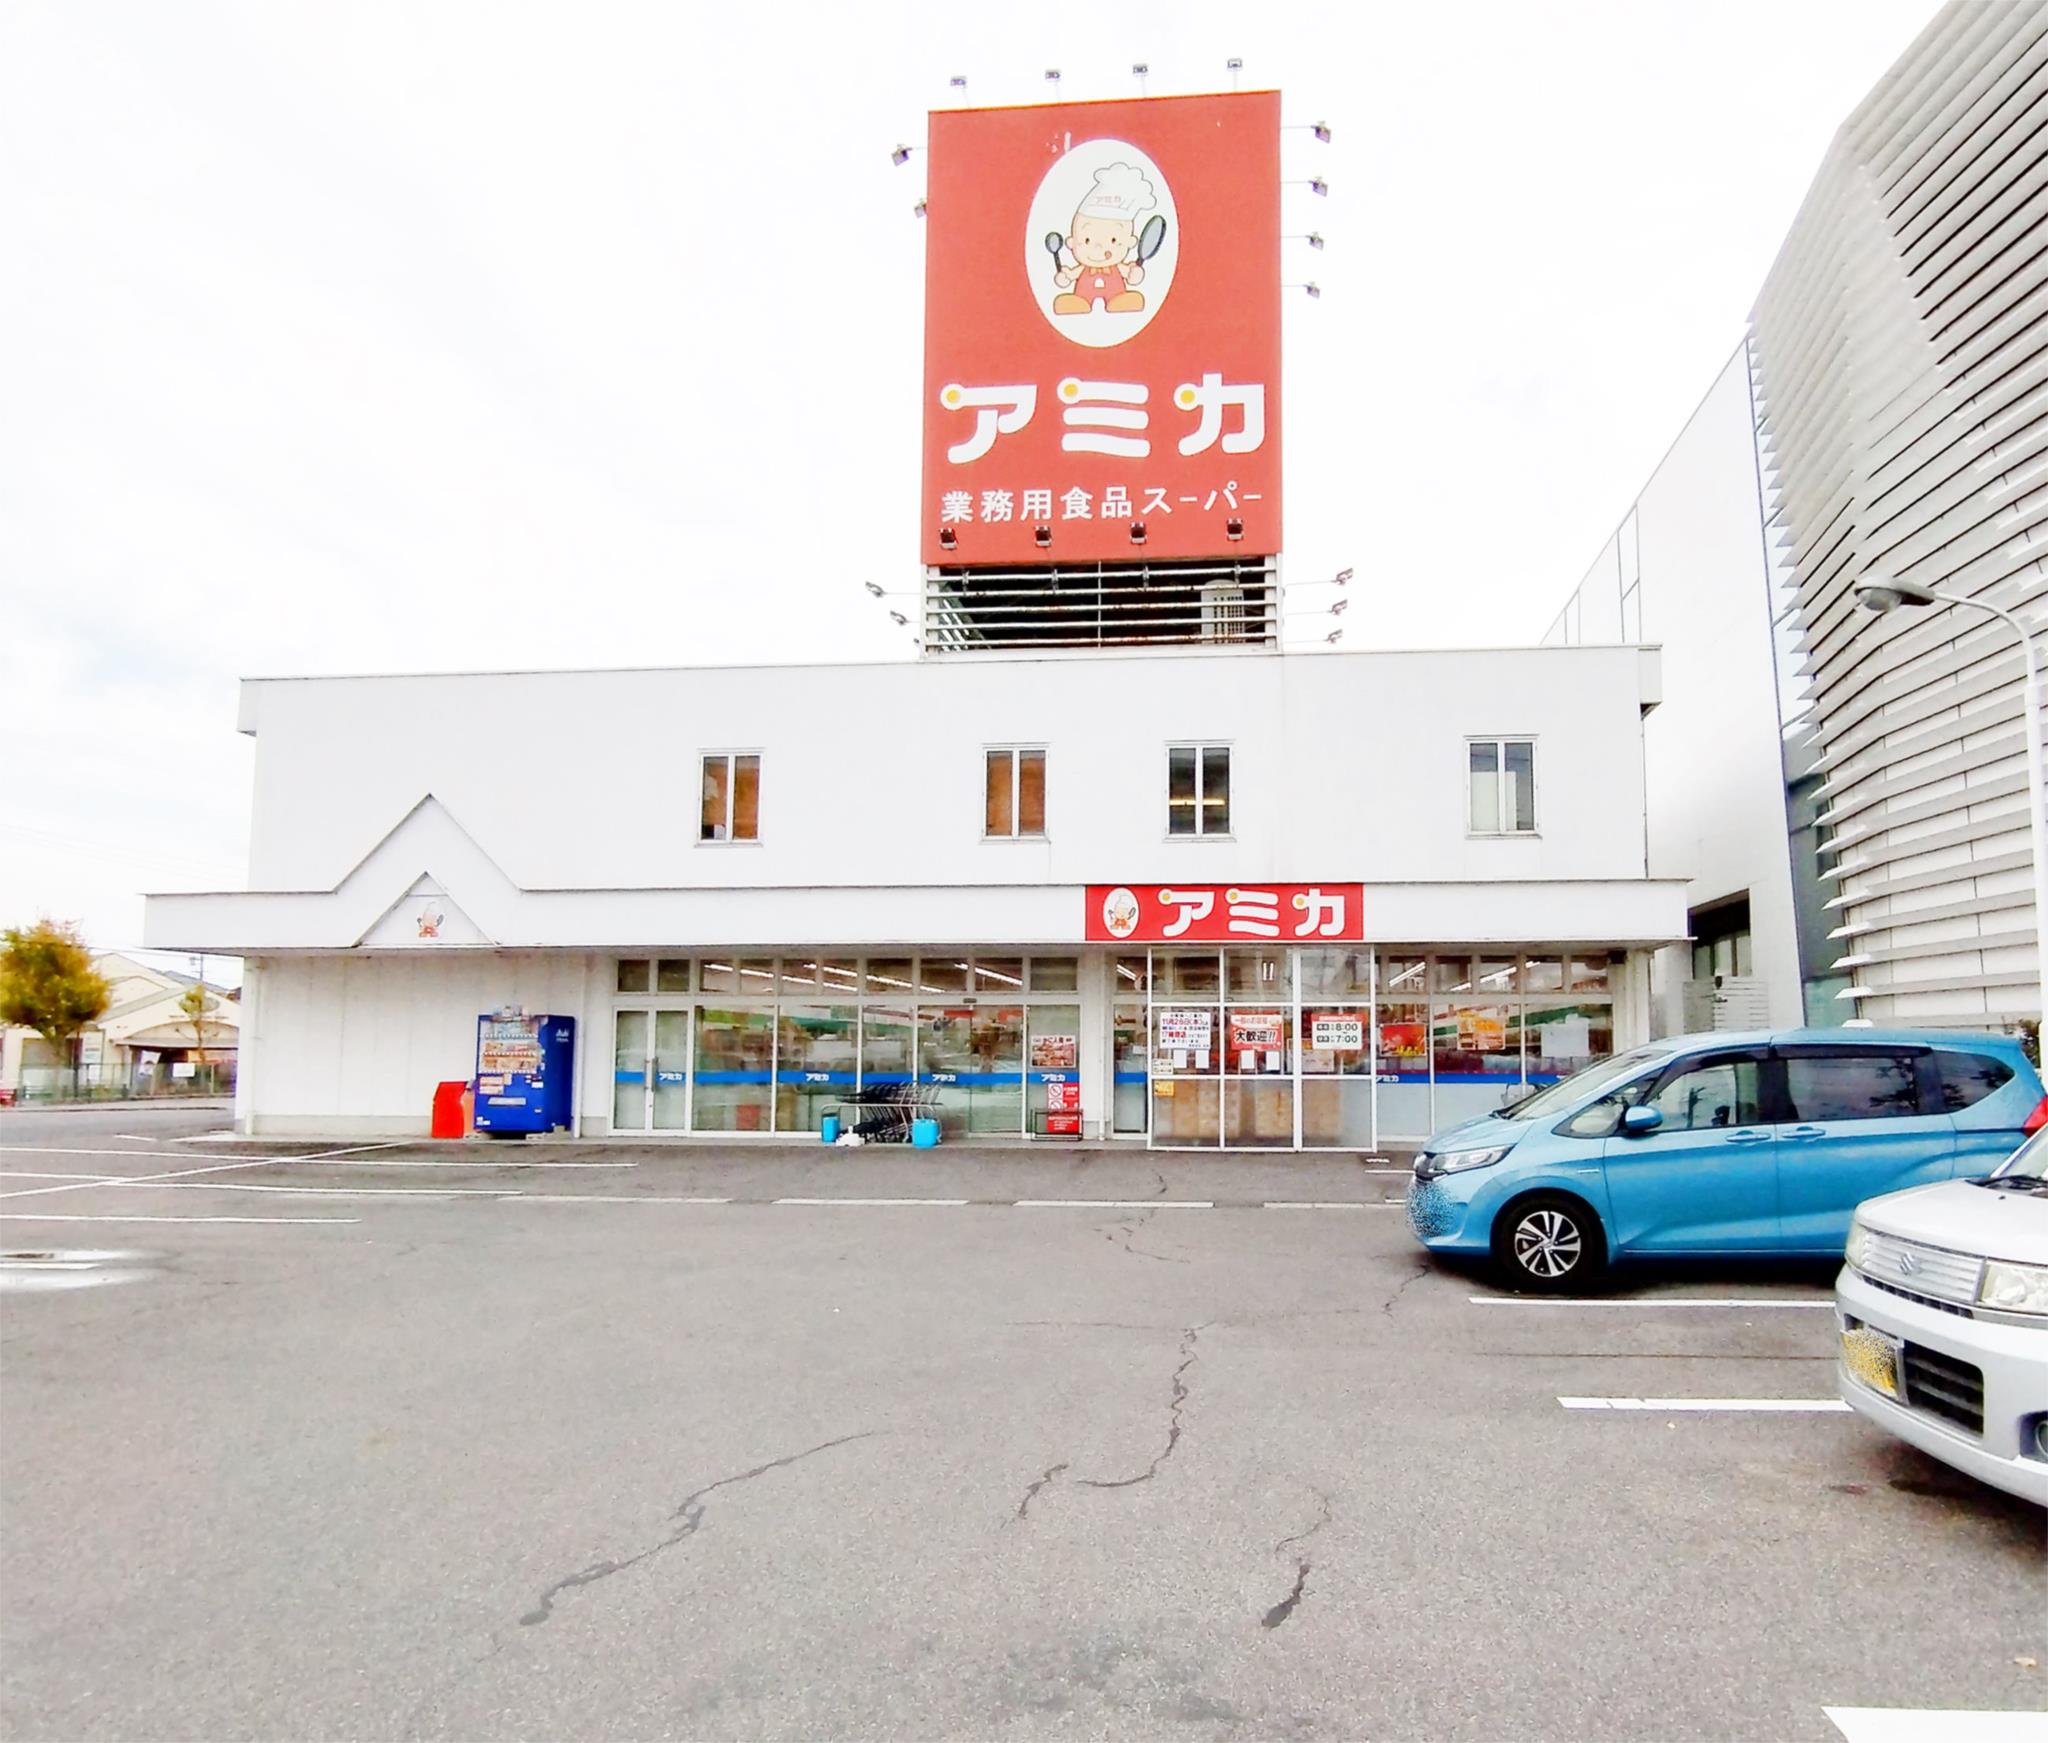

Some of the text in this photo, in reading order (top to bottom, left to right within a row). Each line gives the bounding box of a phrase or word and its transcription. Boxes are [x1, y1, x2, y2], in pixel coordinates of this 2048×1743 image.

[940, 372, 1265, 465] アミカ
[941, 481, 1262, 523] 業務用食品スーパー
[1158, 888, 1345, 937] アミカ
